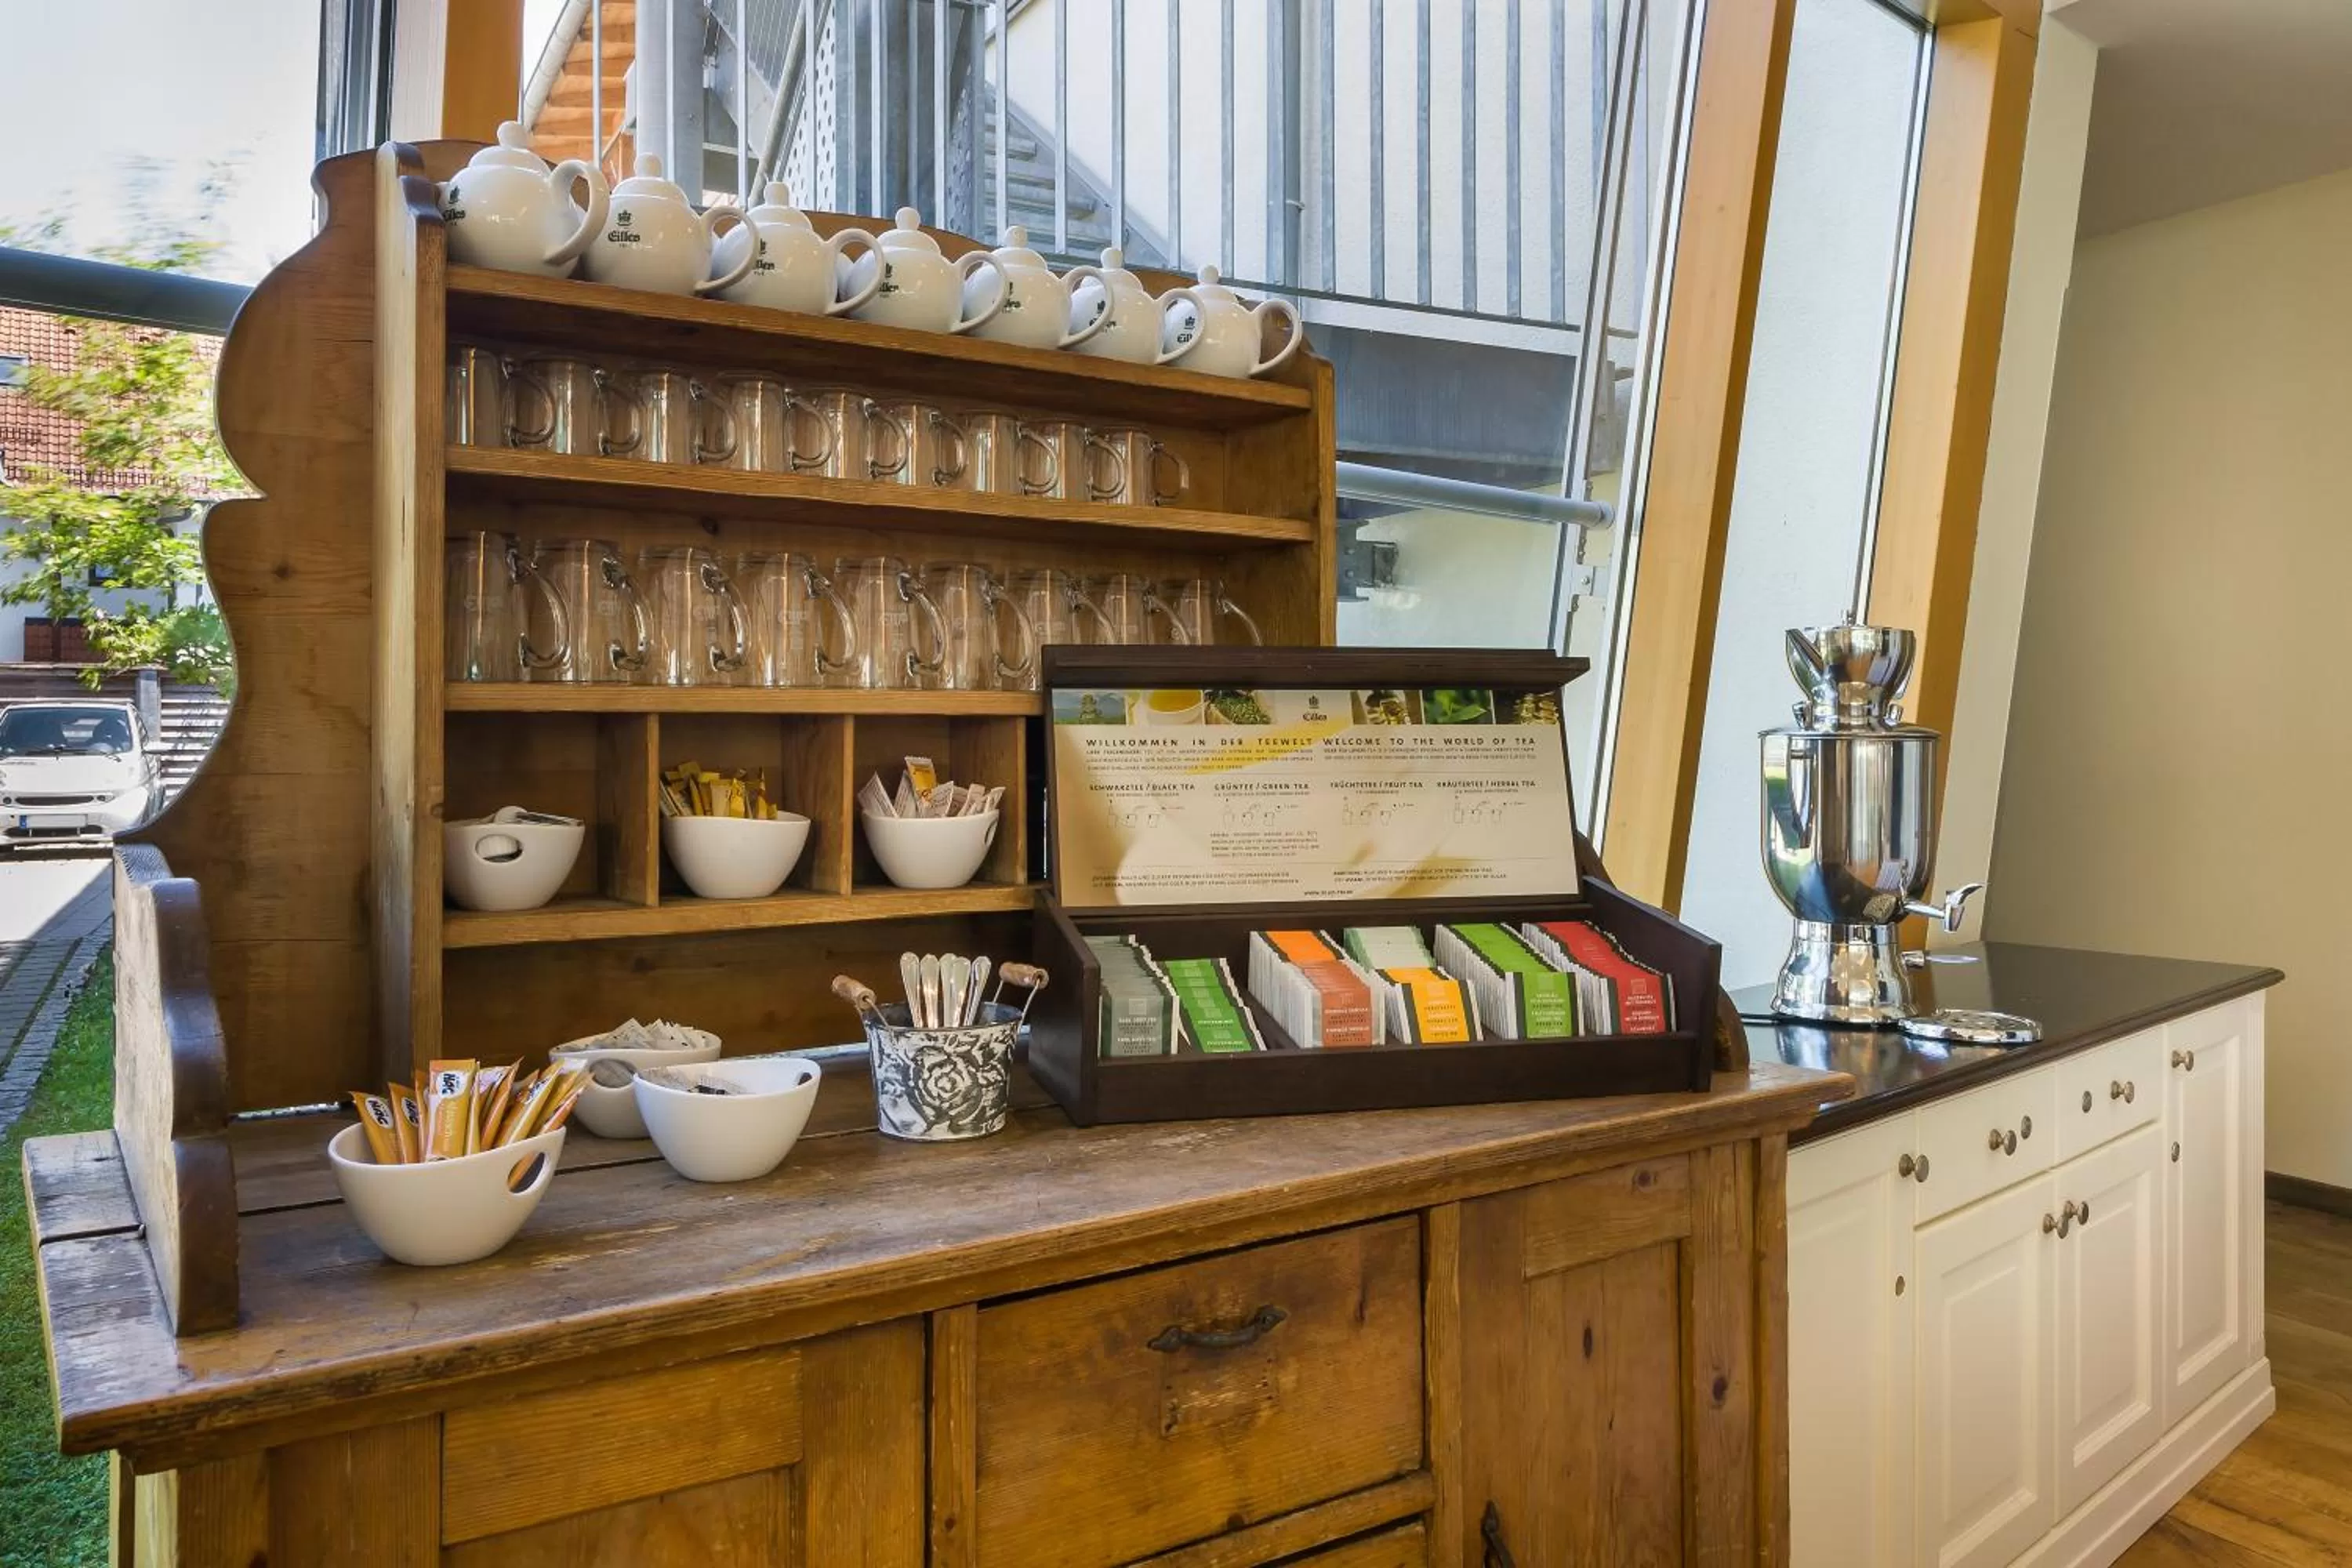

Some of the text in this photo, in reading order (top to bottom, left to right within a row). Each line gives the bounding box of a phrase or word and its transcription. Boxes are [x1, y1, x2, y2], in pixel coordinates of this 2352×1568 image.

[608, 230, 641, 242] Eilles
[1086, 739, 1179, 747] WILLKOMMEN
[1257, 738, 1313, 746] TEEWELT
[1323, 737, 1381, 746] WELCOME
[1389, 737, 1405, 746] TO
[1412, 737, 1434, 746] THE
[1443, 737, 1485, 746] WORLD
[1492, 737, 1507, 746] OF
